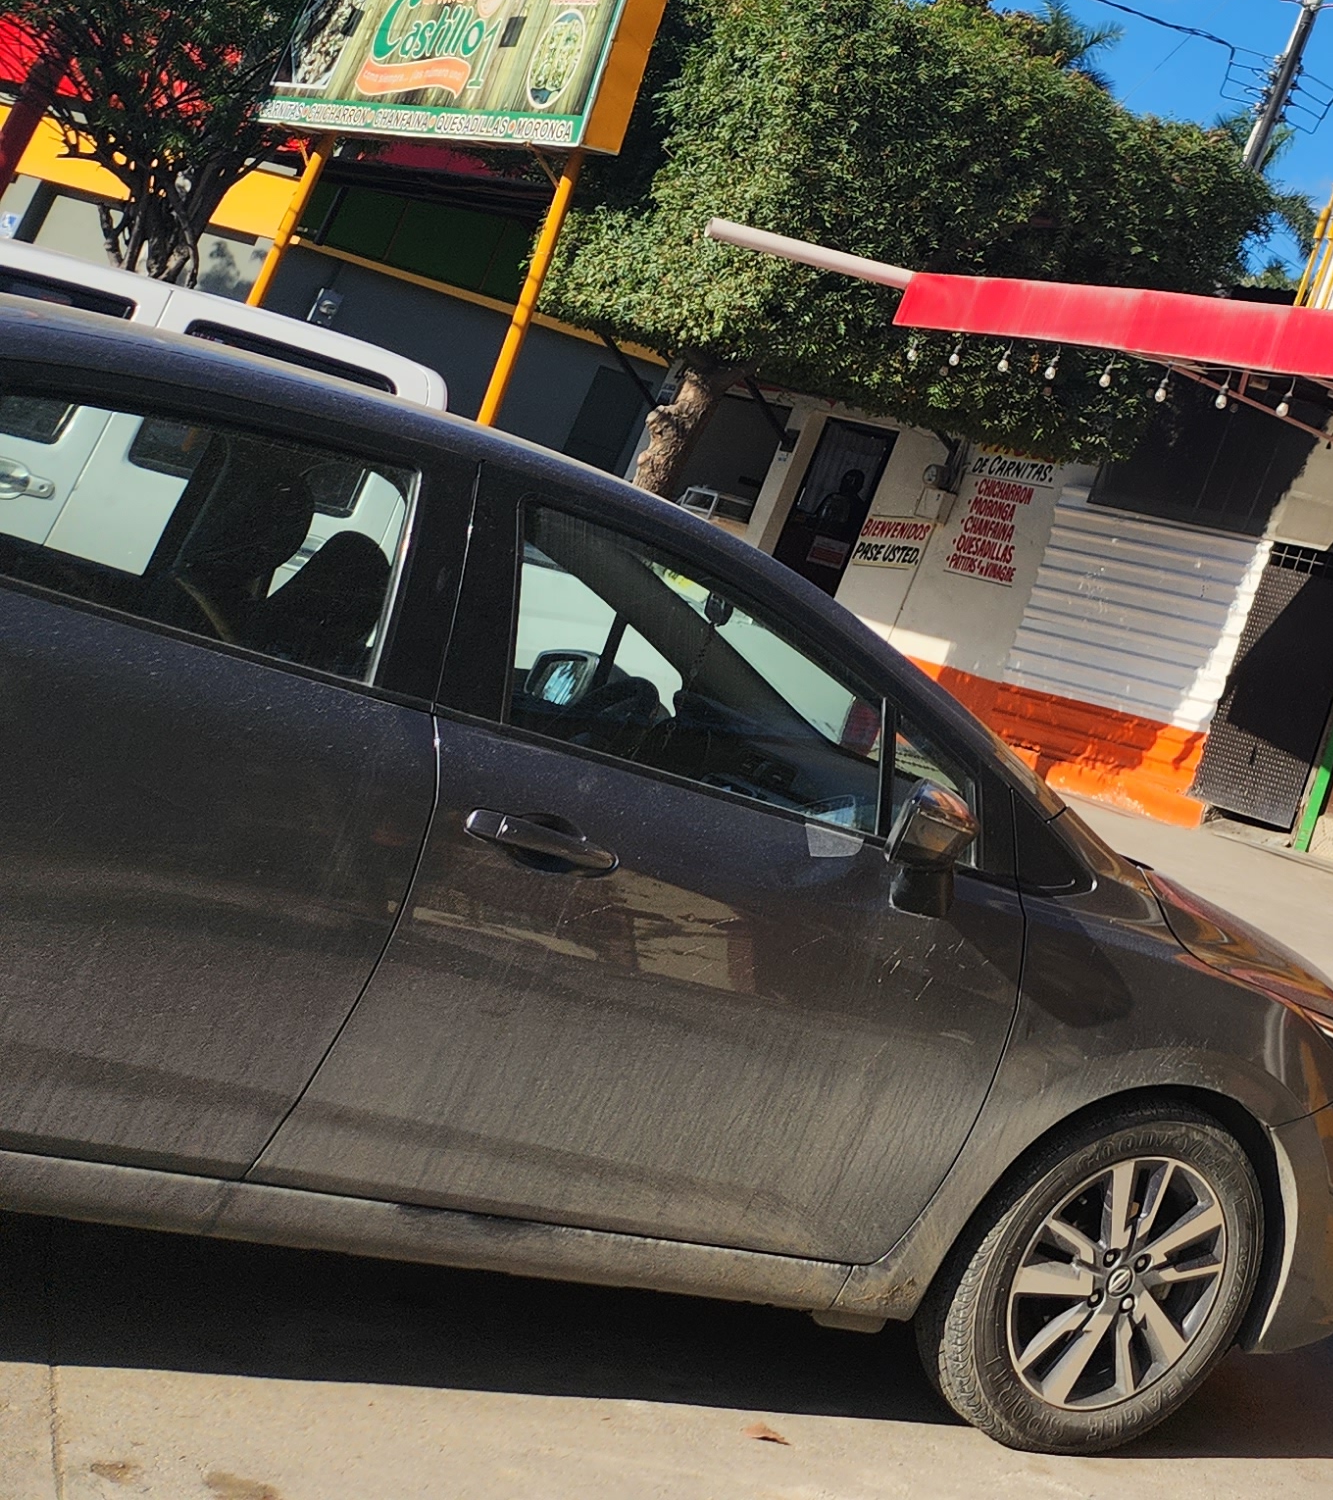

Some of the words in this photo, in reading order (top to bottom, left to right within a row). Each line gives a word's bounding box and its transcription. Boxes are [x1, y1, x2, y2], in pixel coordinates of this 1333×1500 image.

[306, 103, 370, 126] CHICHARRON
[435, 112, 509, 138] QUESADILLAS
[513, 116, 574, 142] MORONGA
[971, 456, 989, 474] DE
[977, 478, 1034, 505] CHICHARRON
[969, 498, 1017, 522] MORONGA
[860, 518, 931, 541] BIENVENIDOS
[963, 517, 1016, 542] CHANFAINA
[852, 542, 882, 562] PASE
[956, 534, 1016, 565] QUESADILLAS
